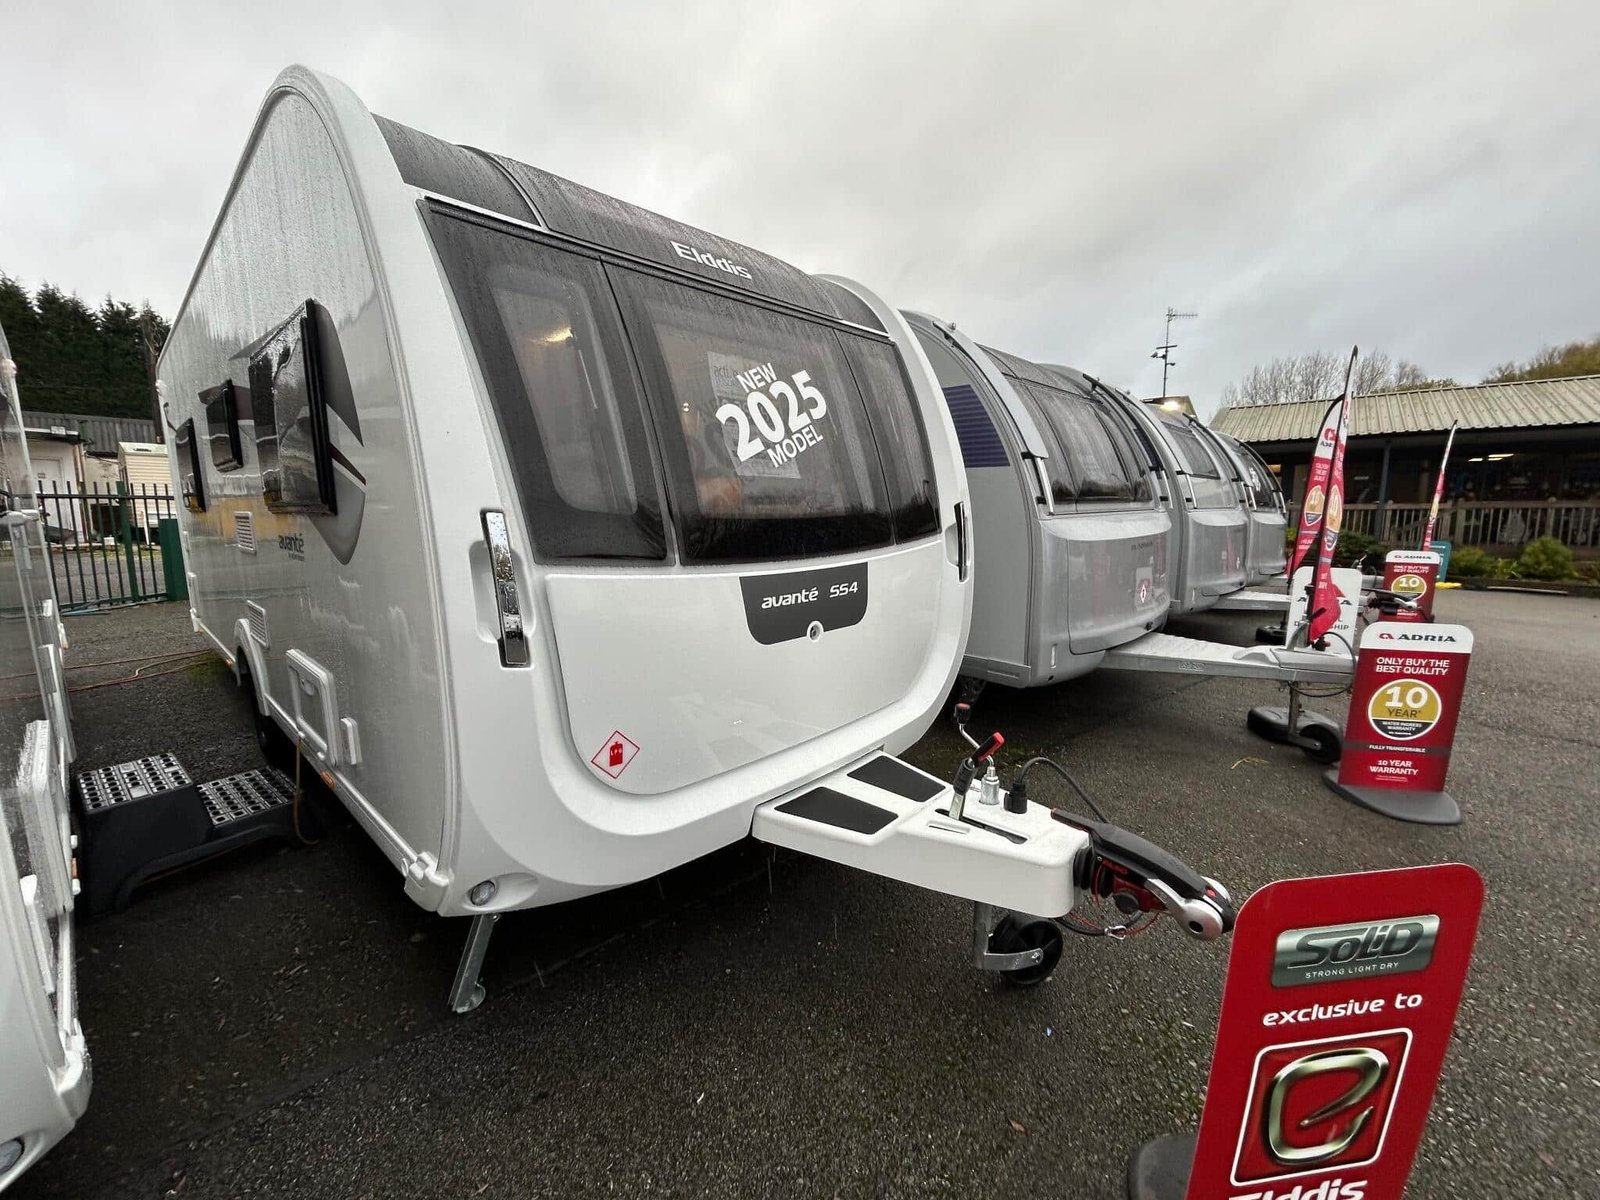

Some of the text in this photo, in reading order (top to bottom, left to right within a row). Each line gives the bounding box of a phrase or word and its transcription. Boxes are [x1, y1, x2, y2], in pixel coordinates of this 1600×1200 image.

[671, 240, 752, 279] Elddis
[736, 362, 777, 393] NEW
[715, 370, 827, 462] 2025
[766, 424, 823, 468] MODEL
[1399, 577, 1420, 588] 10
[761, 586, 819, 609] avanté
[1398, 633, 1456, 643] ADRIA
[1376, 656, 1450, 668] ONLY BUY THE
[1376, 665, 1448, 676] BEST QUALITY
[1385, 686, 1429, 709] 10
[1386, 745, 1426, 753] TRANSFERABLE
[1369, 766, 1419, 776] WARRANTY
[1305, 961, 1399, 979] STRONG LIGHT DRY
[1262, 993, 1423, 1026] exclusive to
